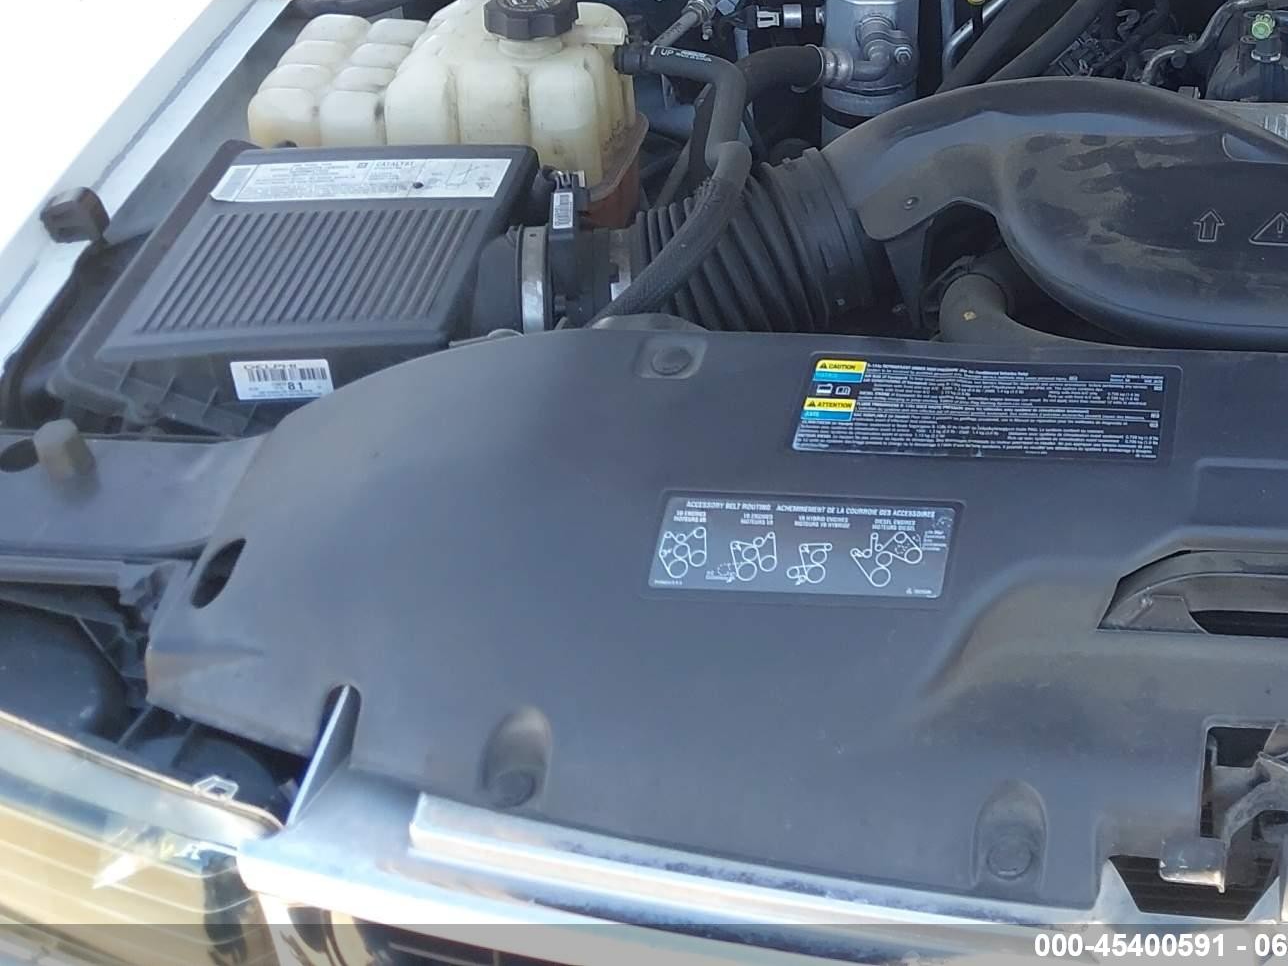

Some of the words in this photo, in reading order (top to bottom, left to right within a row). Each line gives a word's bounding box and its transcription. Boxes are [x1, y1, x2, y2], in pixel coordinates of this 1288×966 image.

[660, 48, 674, 56] UP
[287, 381, 304, 391] 81
[686, 501, 724, 509] ACCESSORY
[725, 502, 741, 510] BELT
[742, 503, 771, 511] ROUTING
